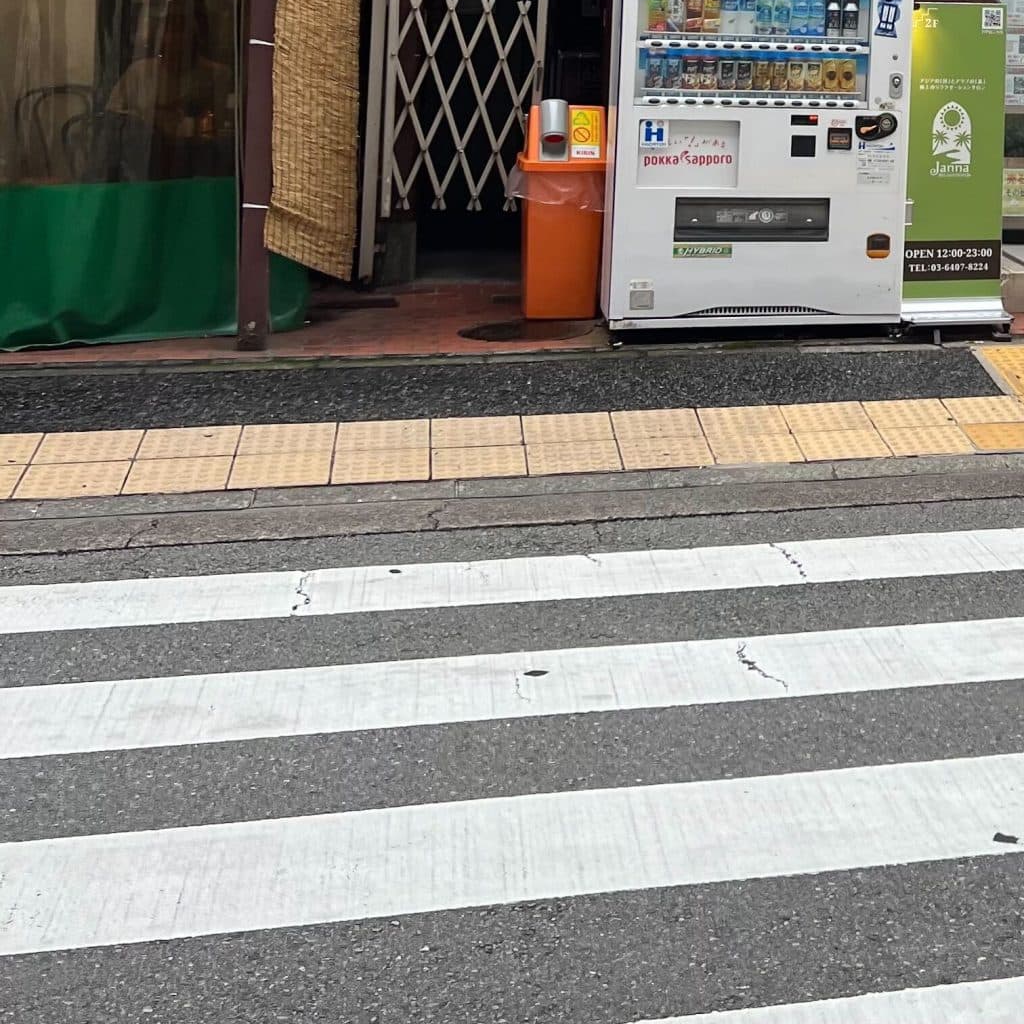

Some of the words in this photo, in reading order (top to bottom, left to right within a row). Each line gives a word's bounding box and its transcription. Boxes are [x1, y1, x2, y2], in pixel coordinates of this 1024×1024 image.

[930, 161, 970, 176] Janna
[905, 249, 934, 259] OPEN
[937, 247, 993, 258] 12:00-23:00
